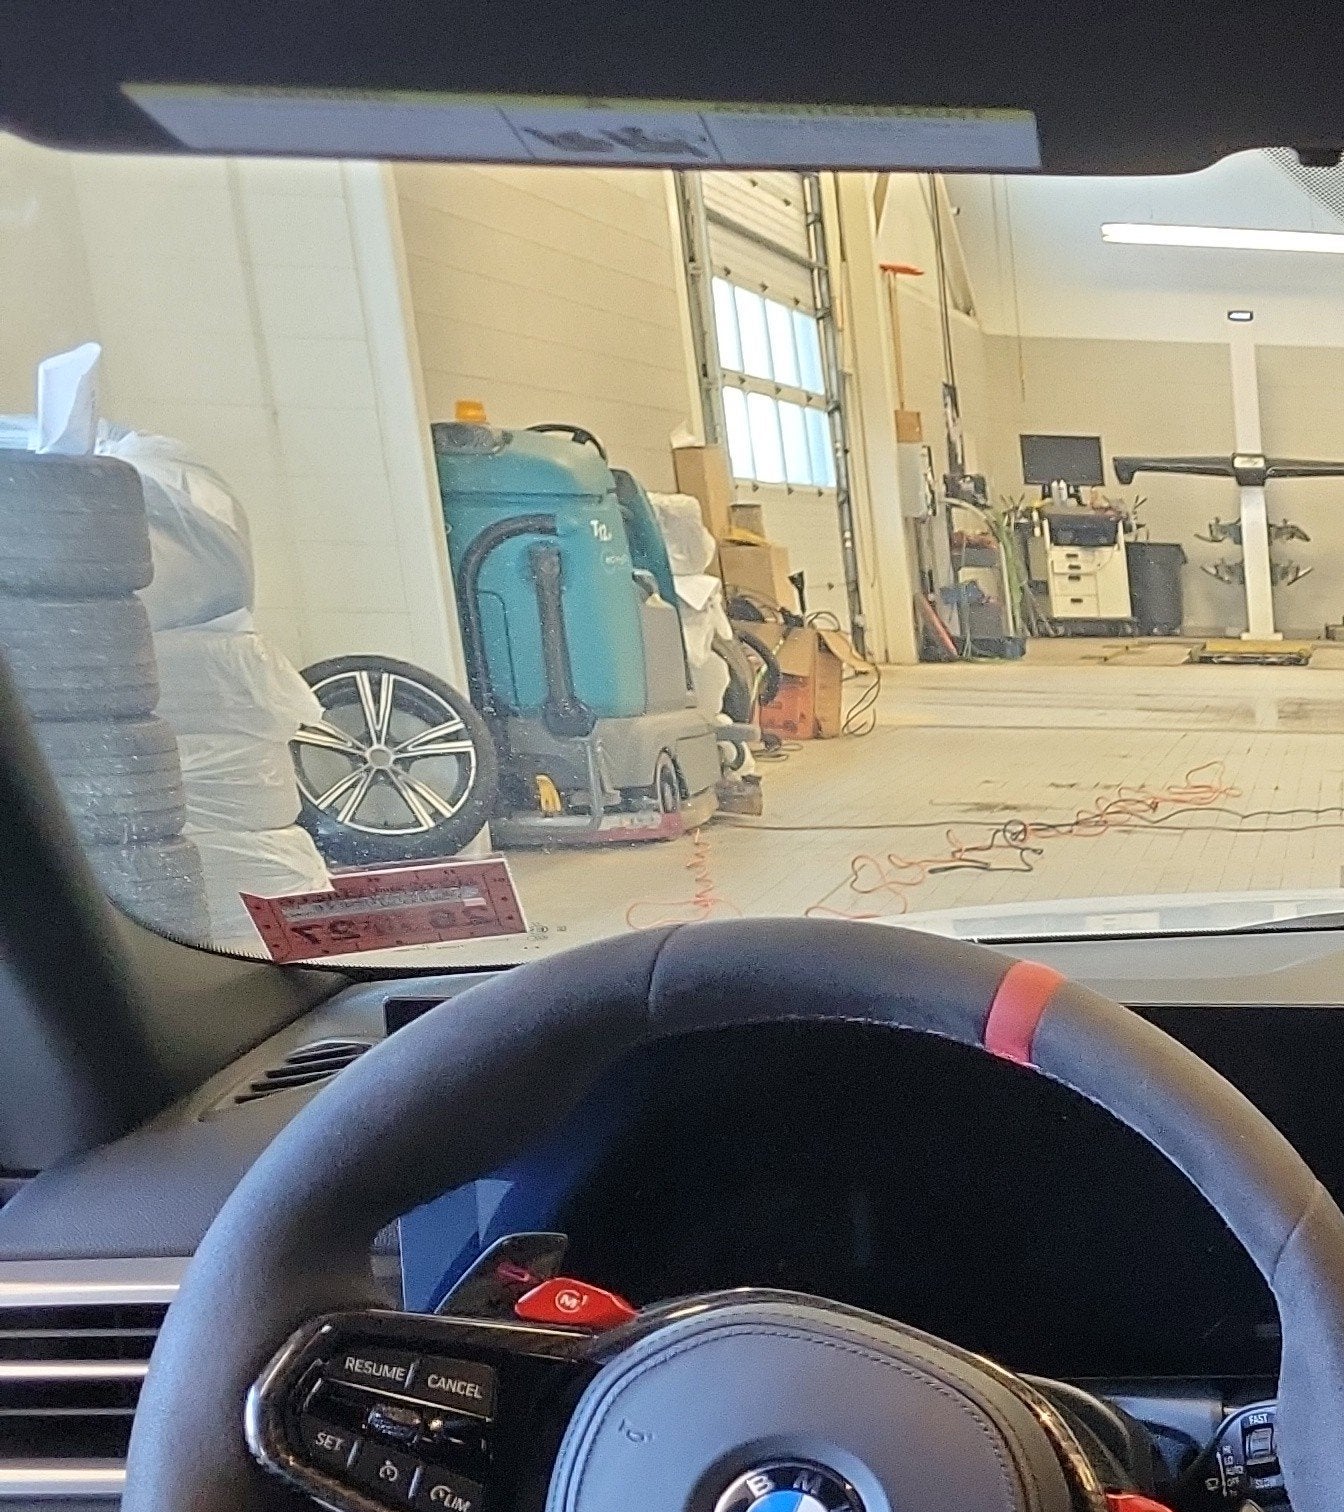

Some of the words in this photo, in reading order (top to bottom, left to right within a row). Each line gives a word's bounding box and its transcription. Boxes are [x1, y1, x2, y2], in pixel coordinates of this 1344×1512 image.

[344, 1356, 406, 1382] RESUME
[427, 1373, 483, 1399] CANCEL
[1248, 1413, 1268, 1425] FAST
[315, 1432, 343, 1451] SET
